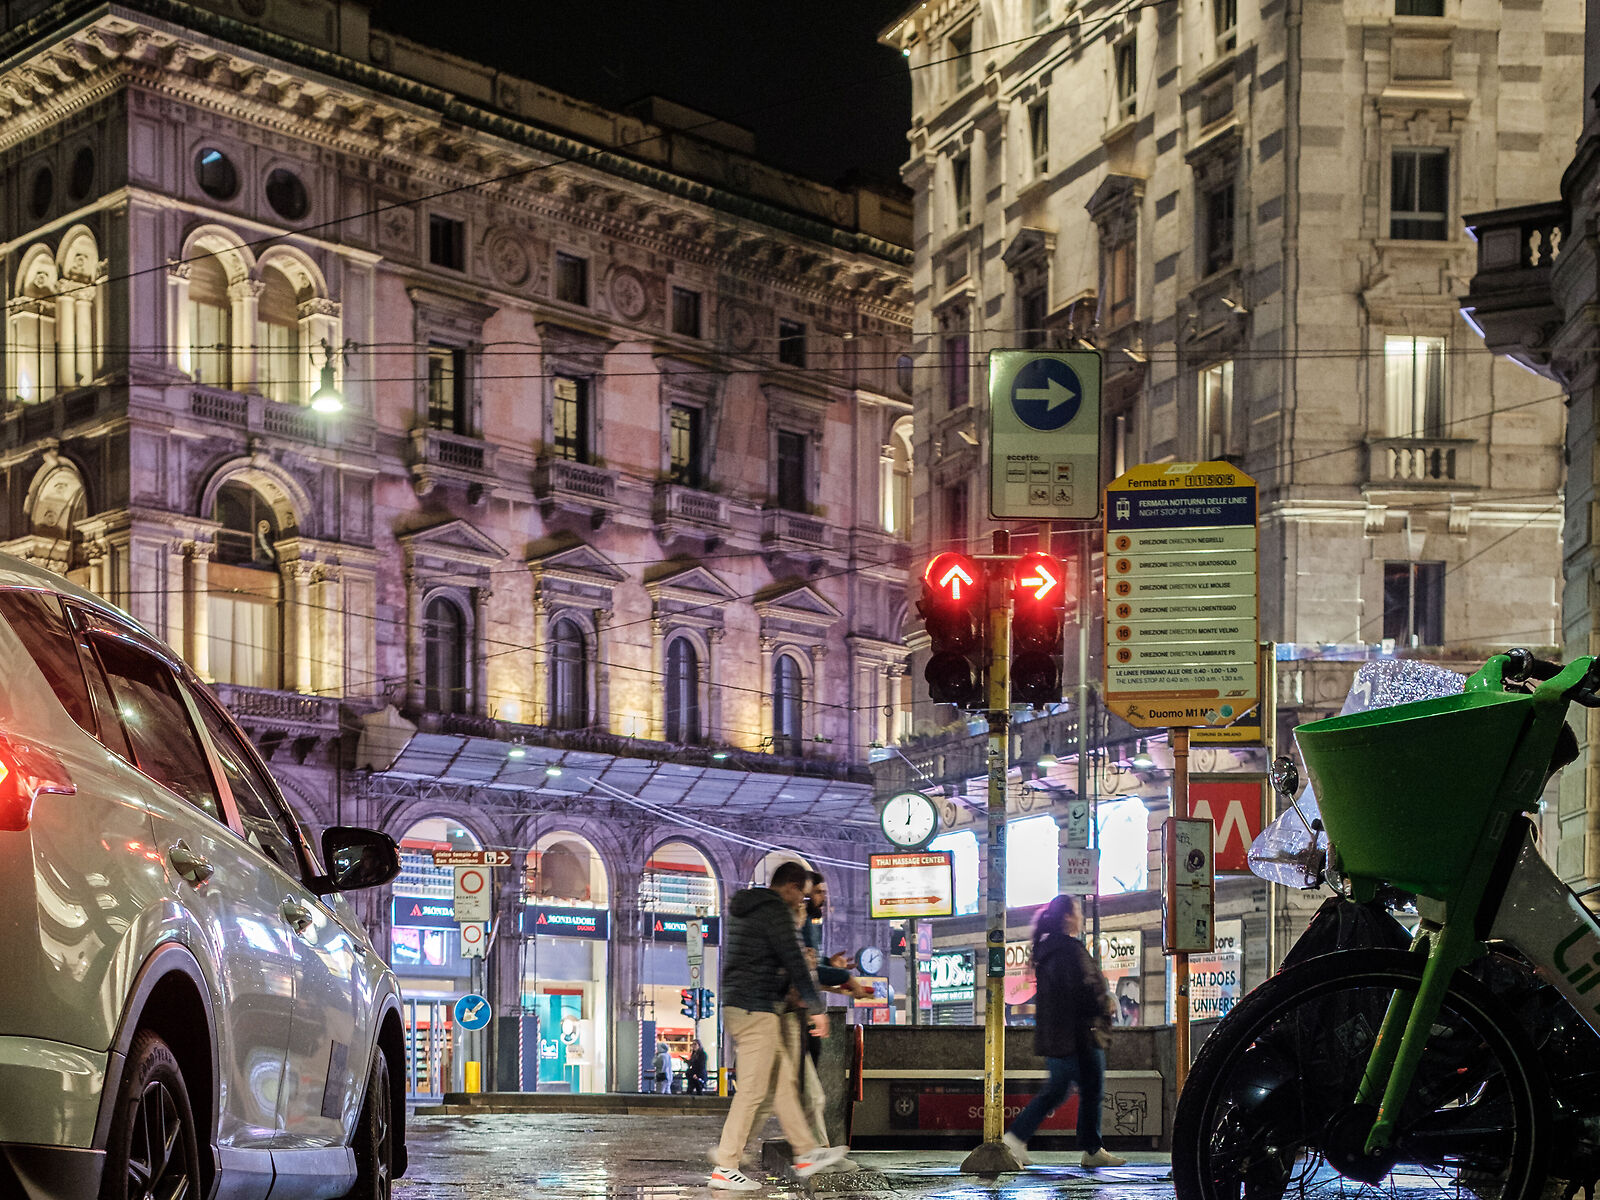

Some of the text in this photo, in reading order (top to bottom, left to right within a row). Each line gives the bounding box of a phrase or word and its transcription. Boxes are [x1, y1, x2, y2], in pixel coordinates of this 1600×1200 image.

[1128, 475, 1236, 488] Fermata n° 11505
[1139, 509, 1159, 517] NIGHT
[1160, 508, 1178, 516] STOP
[1187, 507, 1201, 515] THE
[1120, 539, 1126, 548] 2
[1120, 561, 1127, 570] 3
[1119, 584, 1129, 593] 12
[1119, 607, 1129, 615] 14
[1119, 629, 1129, 638] 16
[1119, 651, 1129, 660] 19
[1149, 709, 1184, 719] Duomo
[1185, 708, 1198, 718] M1
[1190, 800, 1254, 853] M
[876, 856, 945, 866] THAI MASSAGE CENTER
[1067, 867, 1090, 875] area
[422, 905, 455, 917] MONDA
[547, 914, 596, 926] MONDADORI
[1215, 936, 1234, 949] tore
[1190, 971, 1236, 987] HAT DOES
